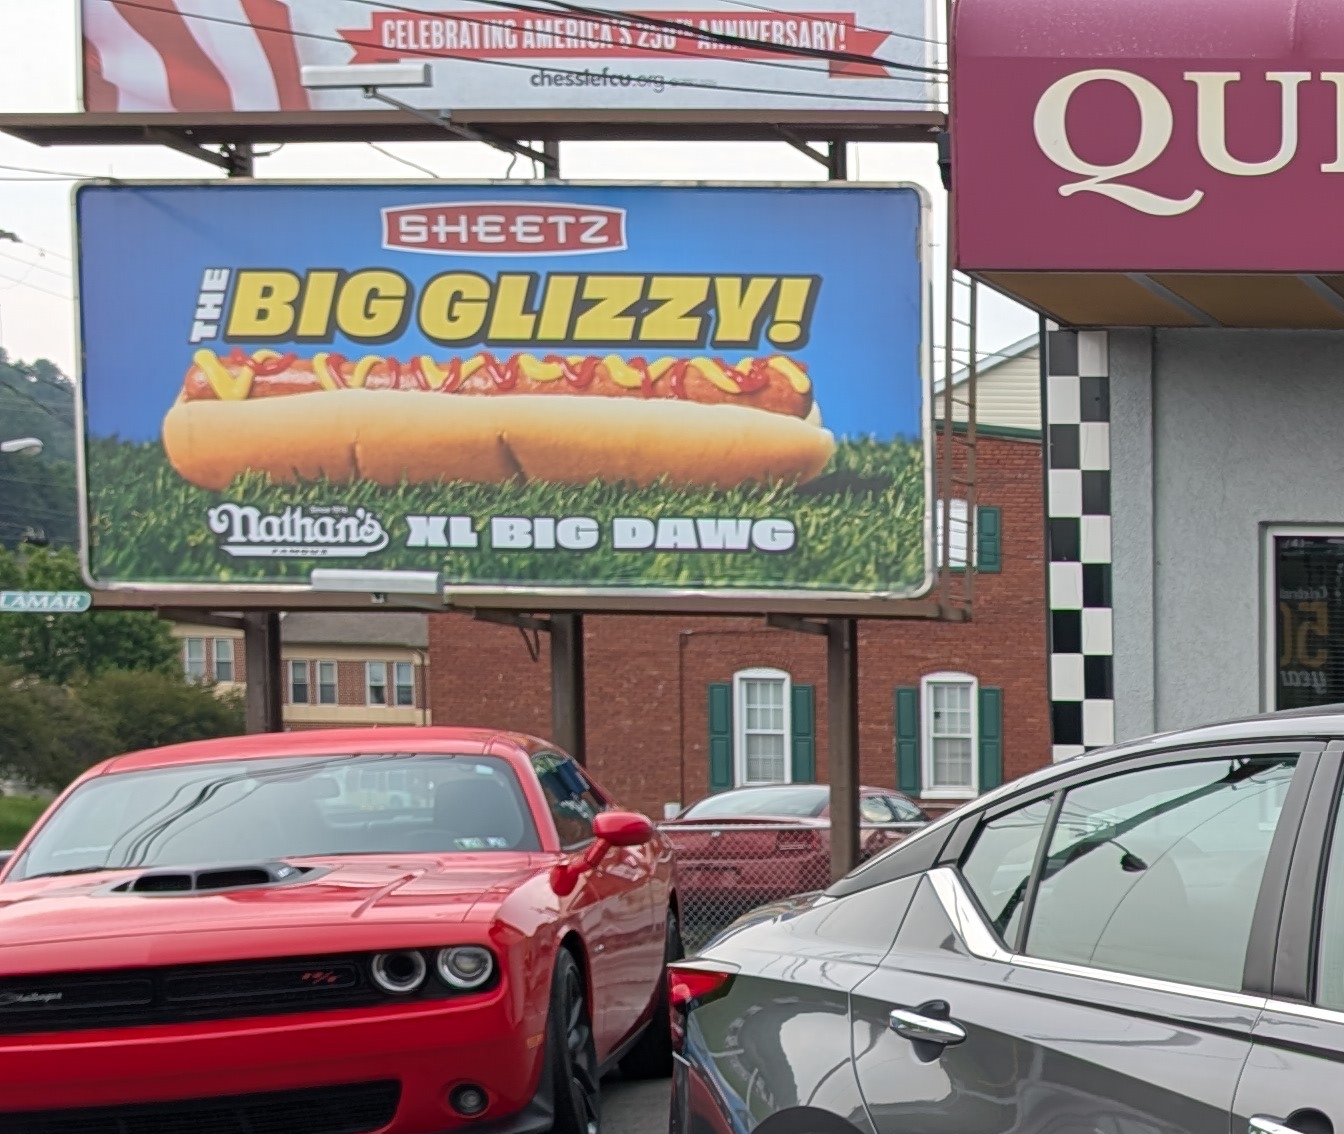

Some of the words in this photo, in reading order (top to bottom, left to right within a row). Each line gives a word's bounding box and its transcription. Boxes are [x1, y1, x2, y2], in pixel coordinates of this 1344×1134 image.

[381, 19, 518, 50] CELEBRATING
[398, 214, 610, 246] SHEETZ
[189, 268, 231, 344] THE
[226, 269, 409, 340] BIG
[418, 270, 815, 346] GLIZZY!
[207, 503, 384, 544] Nathan's
[404, 515, 479, 548] XL
[490, 516, 600, 550] BIG
[612, 517, 796, 551] DAWG
[0, 594, 81, 609] LAMAR
